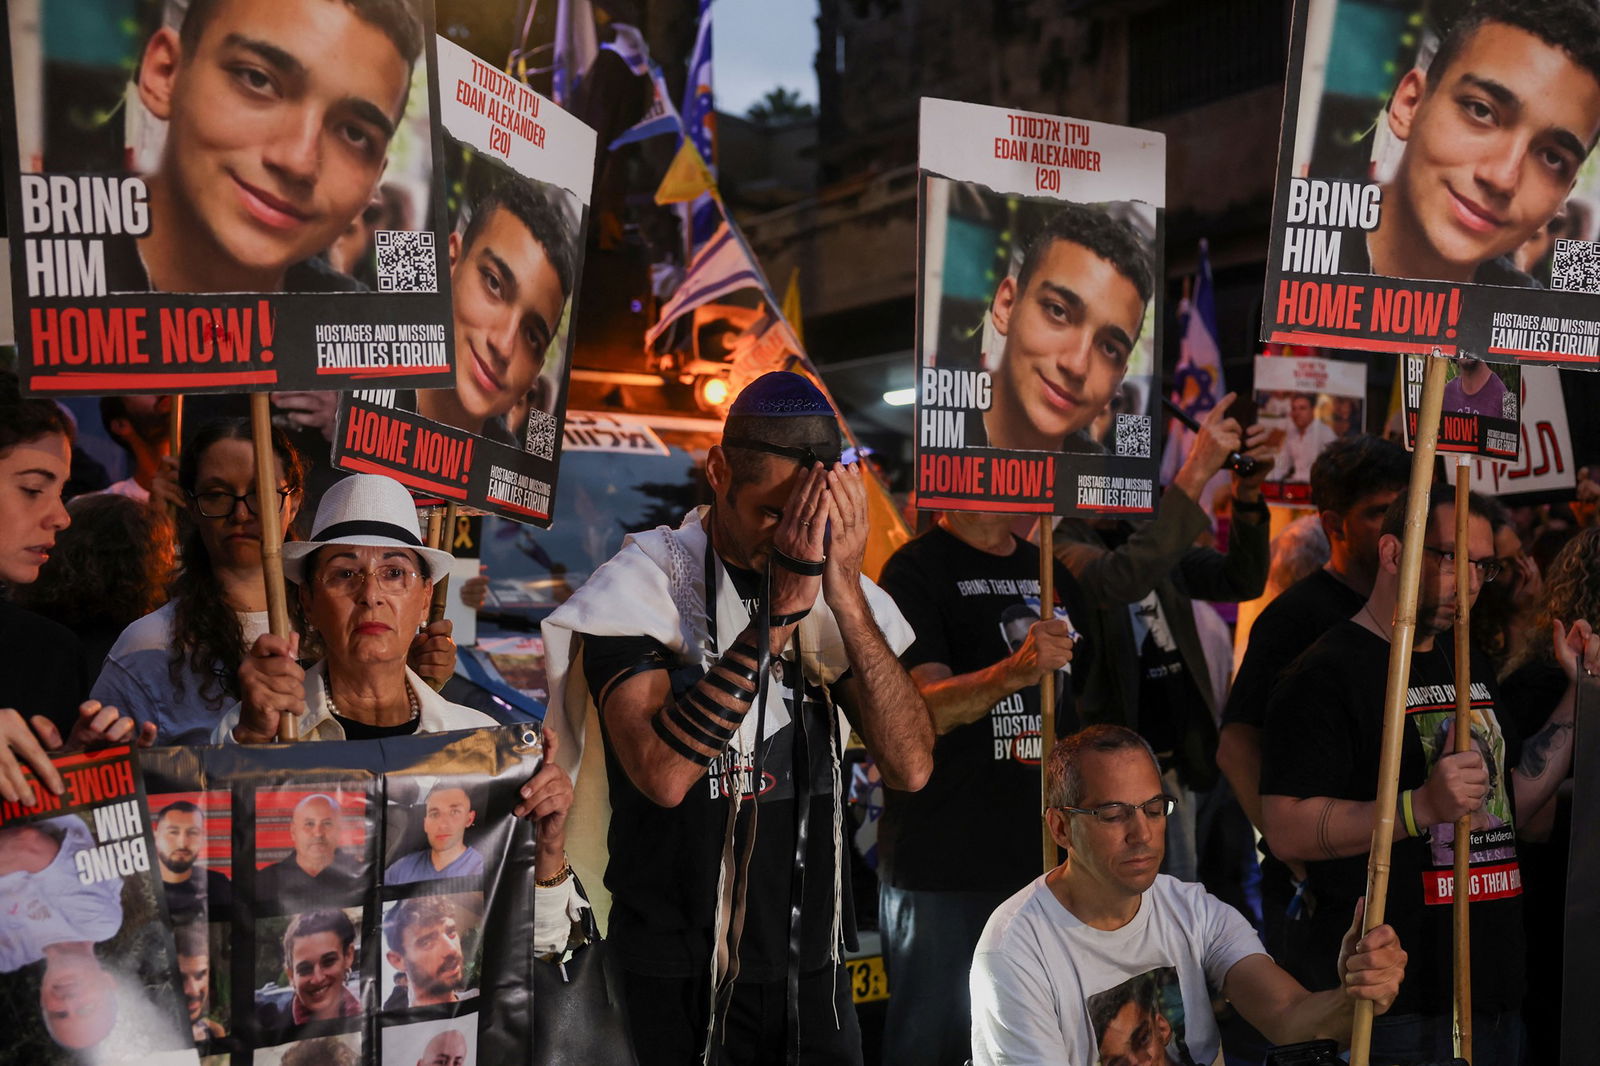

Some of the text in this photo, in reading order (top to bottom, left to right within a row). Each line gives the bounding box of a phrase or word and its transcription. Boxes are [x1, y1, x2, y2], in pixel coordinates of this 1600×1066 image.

[472, 59, 540, 118] עידן אלכסנדר
[456, 79, 546, 149] EDAN ALEXANDER
[1007, 115, 1089, 146] עידן אלכסנדר
[490, 124, 511, 158] (20)
[994, 138, 1100, 172] EDAN ALEXANDER
[1036, 167, 1060, 192] (20)
[20, 175, 150, 235] BRING
[1287, 178, 1381, 229] BRING
[25, 238, 107, 298] HIM
[1282, 228, 1341, 275] HIM
[1276, 280, 1460, 338] HOME NOW!
[1492, 312, 1600, 336] HOSTAGES AND MISSING
[30, 300, 276, 366] HOME NOW!
[316, 324, 445, 342] HOSTAGES AND MISSING
[1490, 328, 1599, 357] FAMILIES FORUM
[317, 342, 446, 368] FAMILIES FORUM
[921, 368, 991, 410] BRING
[1408, 384, 1422, 408] HI
[346, 406, 474, 484] HOME NOW!
[921, 410, 964, 448] HIM
[1444, 415, 1478, 442] NOW!
[490, 465, 518, 486] HOSTAGES
[518, 474, 529, 488] AND
[920, 454, 1055, 498] HOME NOW!
[1078, 475, 1152, 490] HOSTAGES AND MISSING
[488, 478, 550, 514] FAMILIES FORUM
[1078, 488, 1152, 508] FAMILIES FORUM
[958, 580, 990, 596] BRING
[988, 580, 1018, 595] THEM
[992, 715, 1042, 737] HOSTAG
[994, 739, 1012, 760] BY
[64, 760, 136, 806] HOME
[93, 800, 143, 843] HIM
[1470, 834, 1484, 845] fer
[75, 837, 151, 886] BRING
[1482, 871, 1508, 894] THEM
